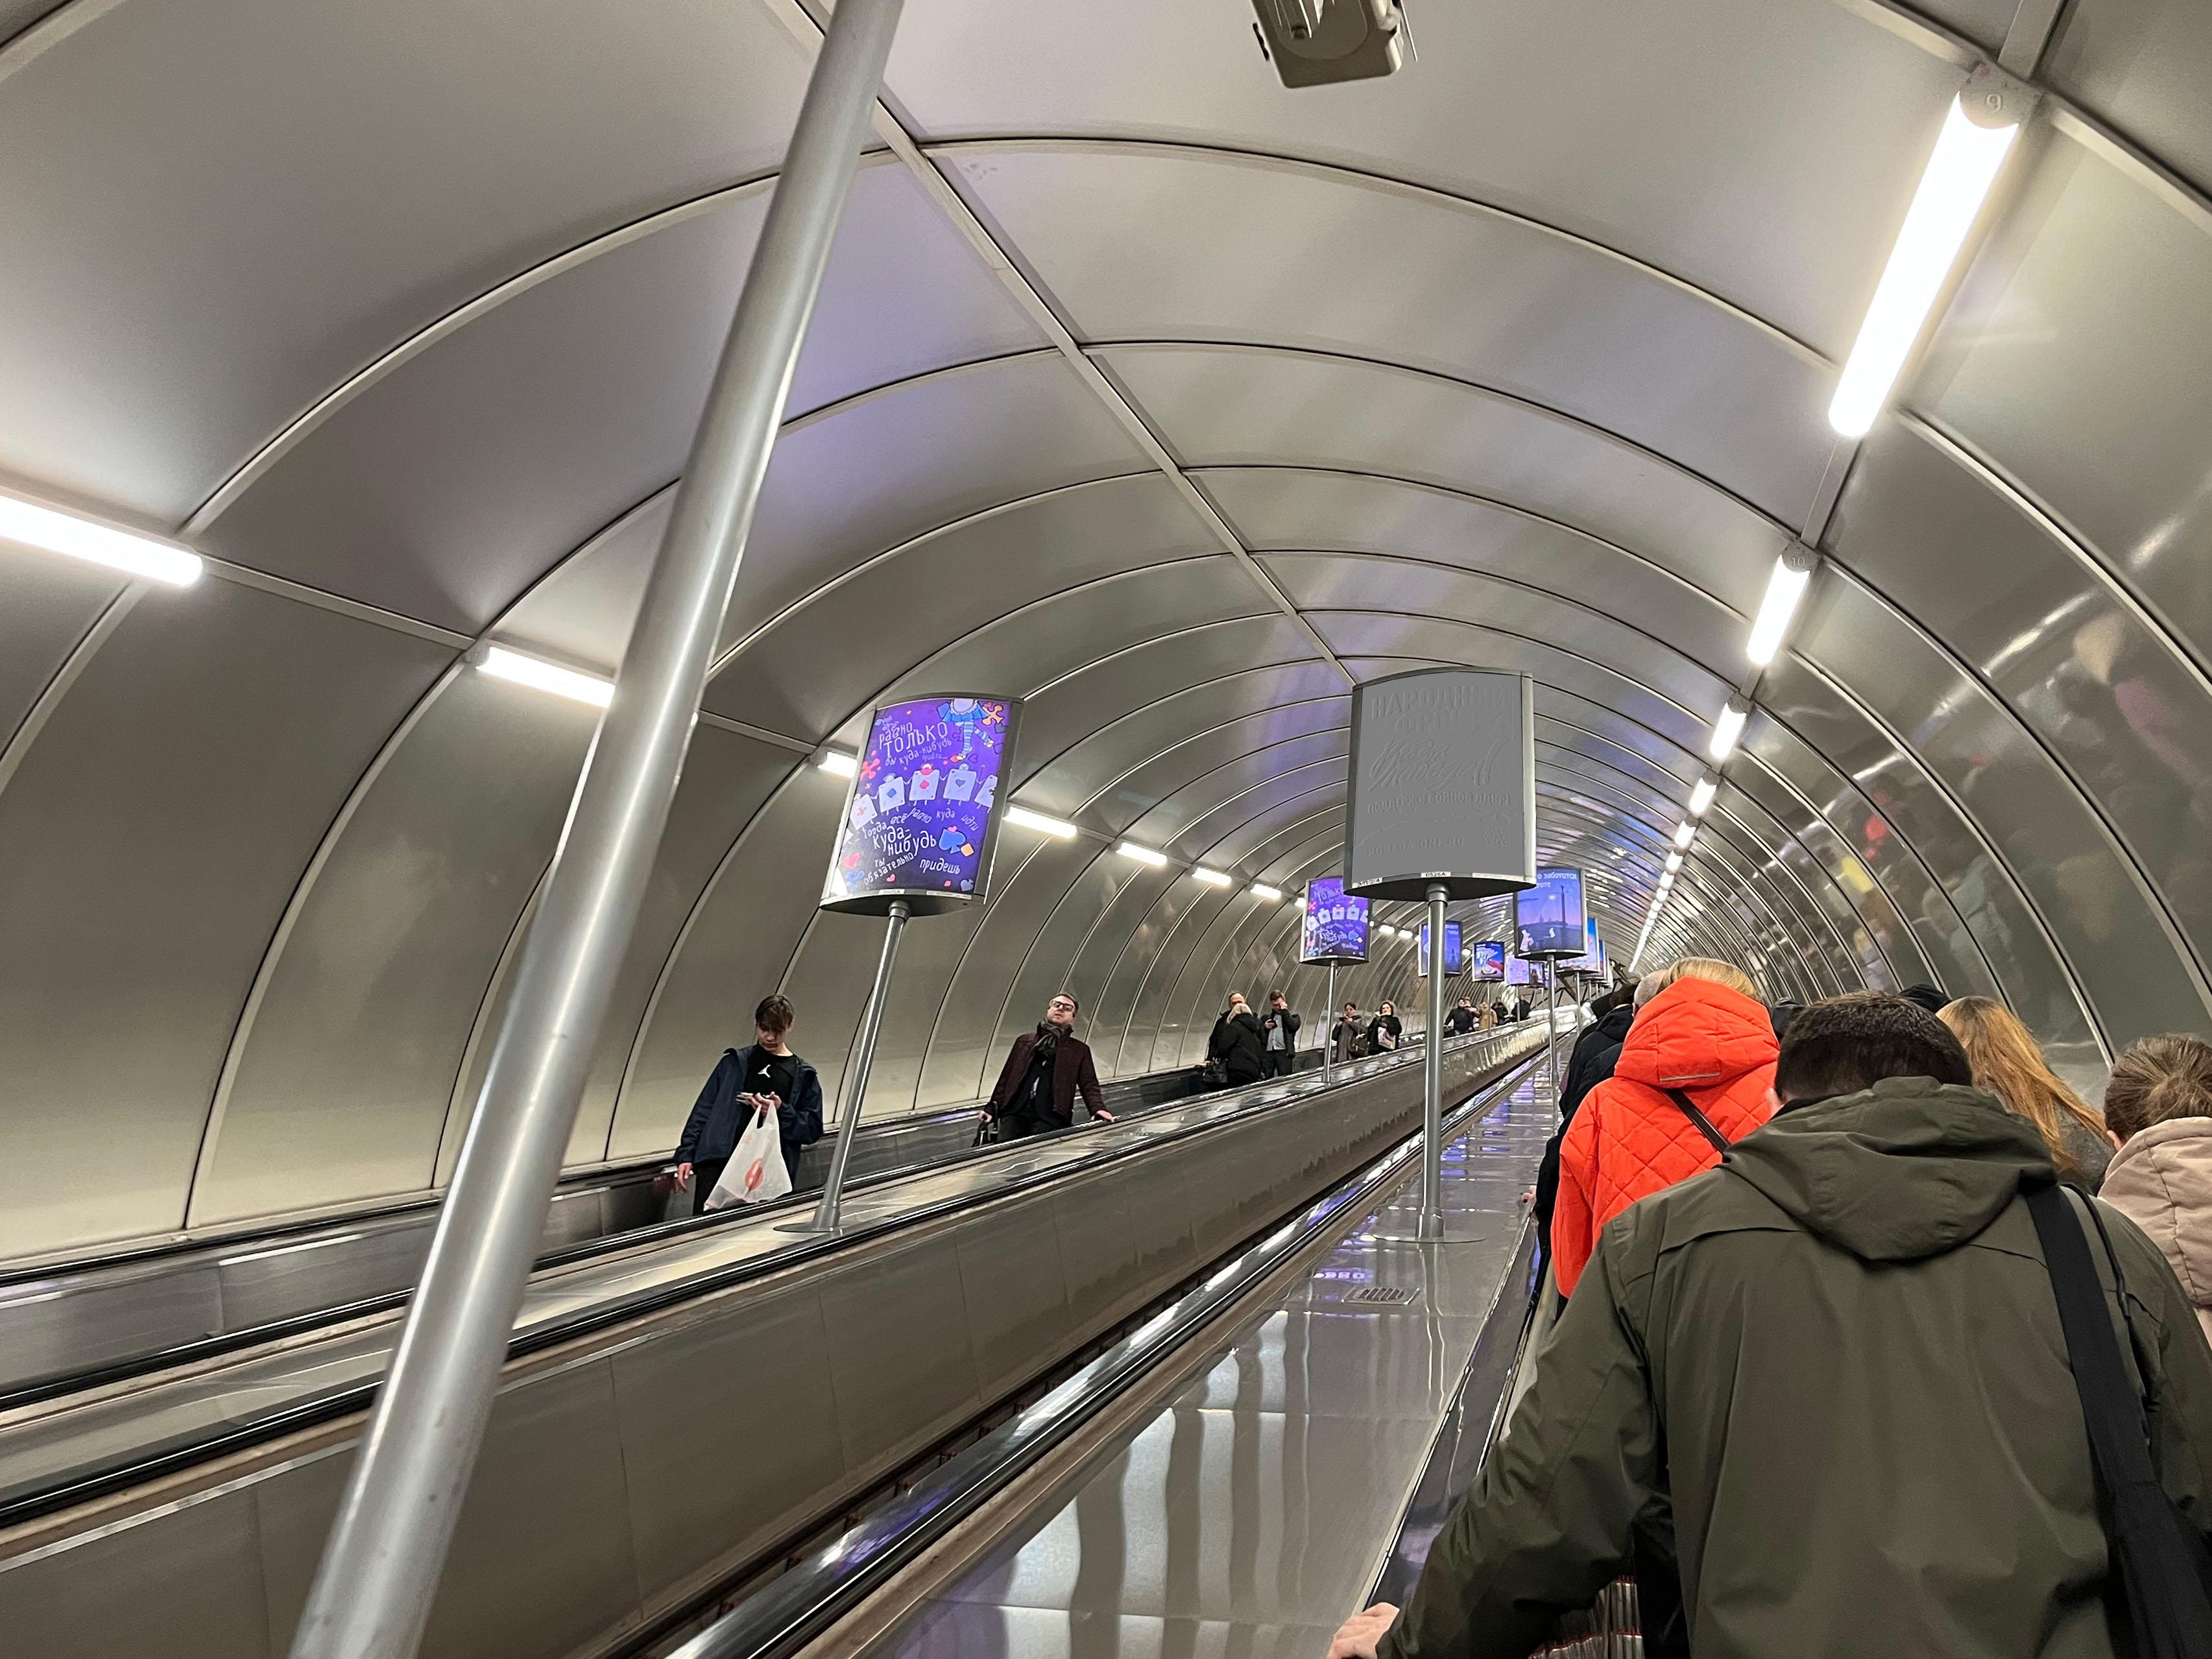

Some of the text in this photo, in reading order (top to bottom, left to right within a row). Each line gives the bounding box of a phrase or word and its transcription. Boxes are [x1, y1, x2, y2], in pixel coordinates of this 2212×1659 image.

[1791, 556, 1806, 566] 10
[936, 808, 956, 822] куда
[961, 814, 980, 831] идти
[887, 831, 937, 856] нибудь
[863, 852, 961, 885] обязательно придешь
[874, 857, 885, 868] ты
